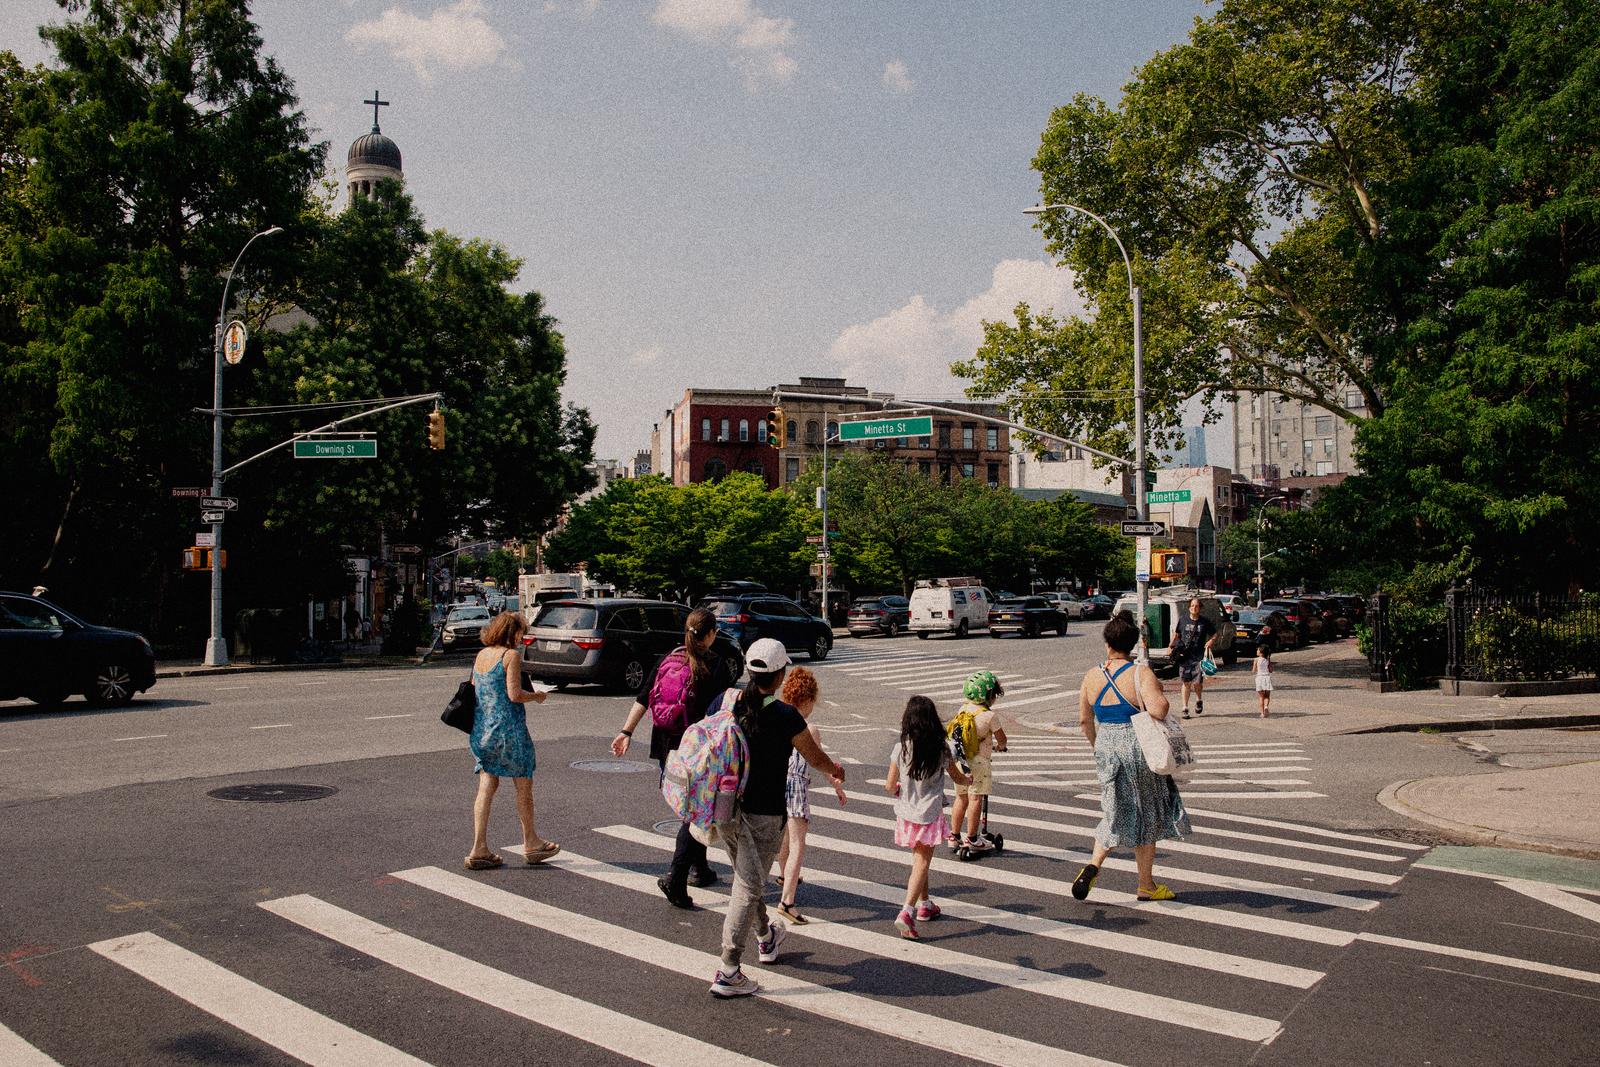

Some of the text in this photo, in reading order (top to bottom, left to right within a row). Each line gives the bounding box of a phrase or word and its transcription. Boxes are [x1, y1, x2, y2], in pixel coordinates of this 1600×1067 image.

[864, 422, 906, 435] Minetta St
[315, 444, 355, 456] Downing St
[172, 488, 207, 497] Downing St
[1150, 492, 1180, 503] Minetta
